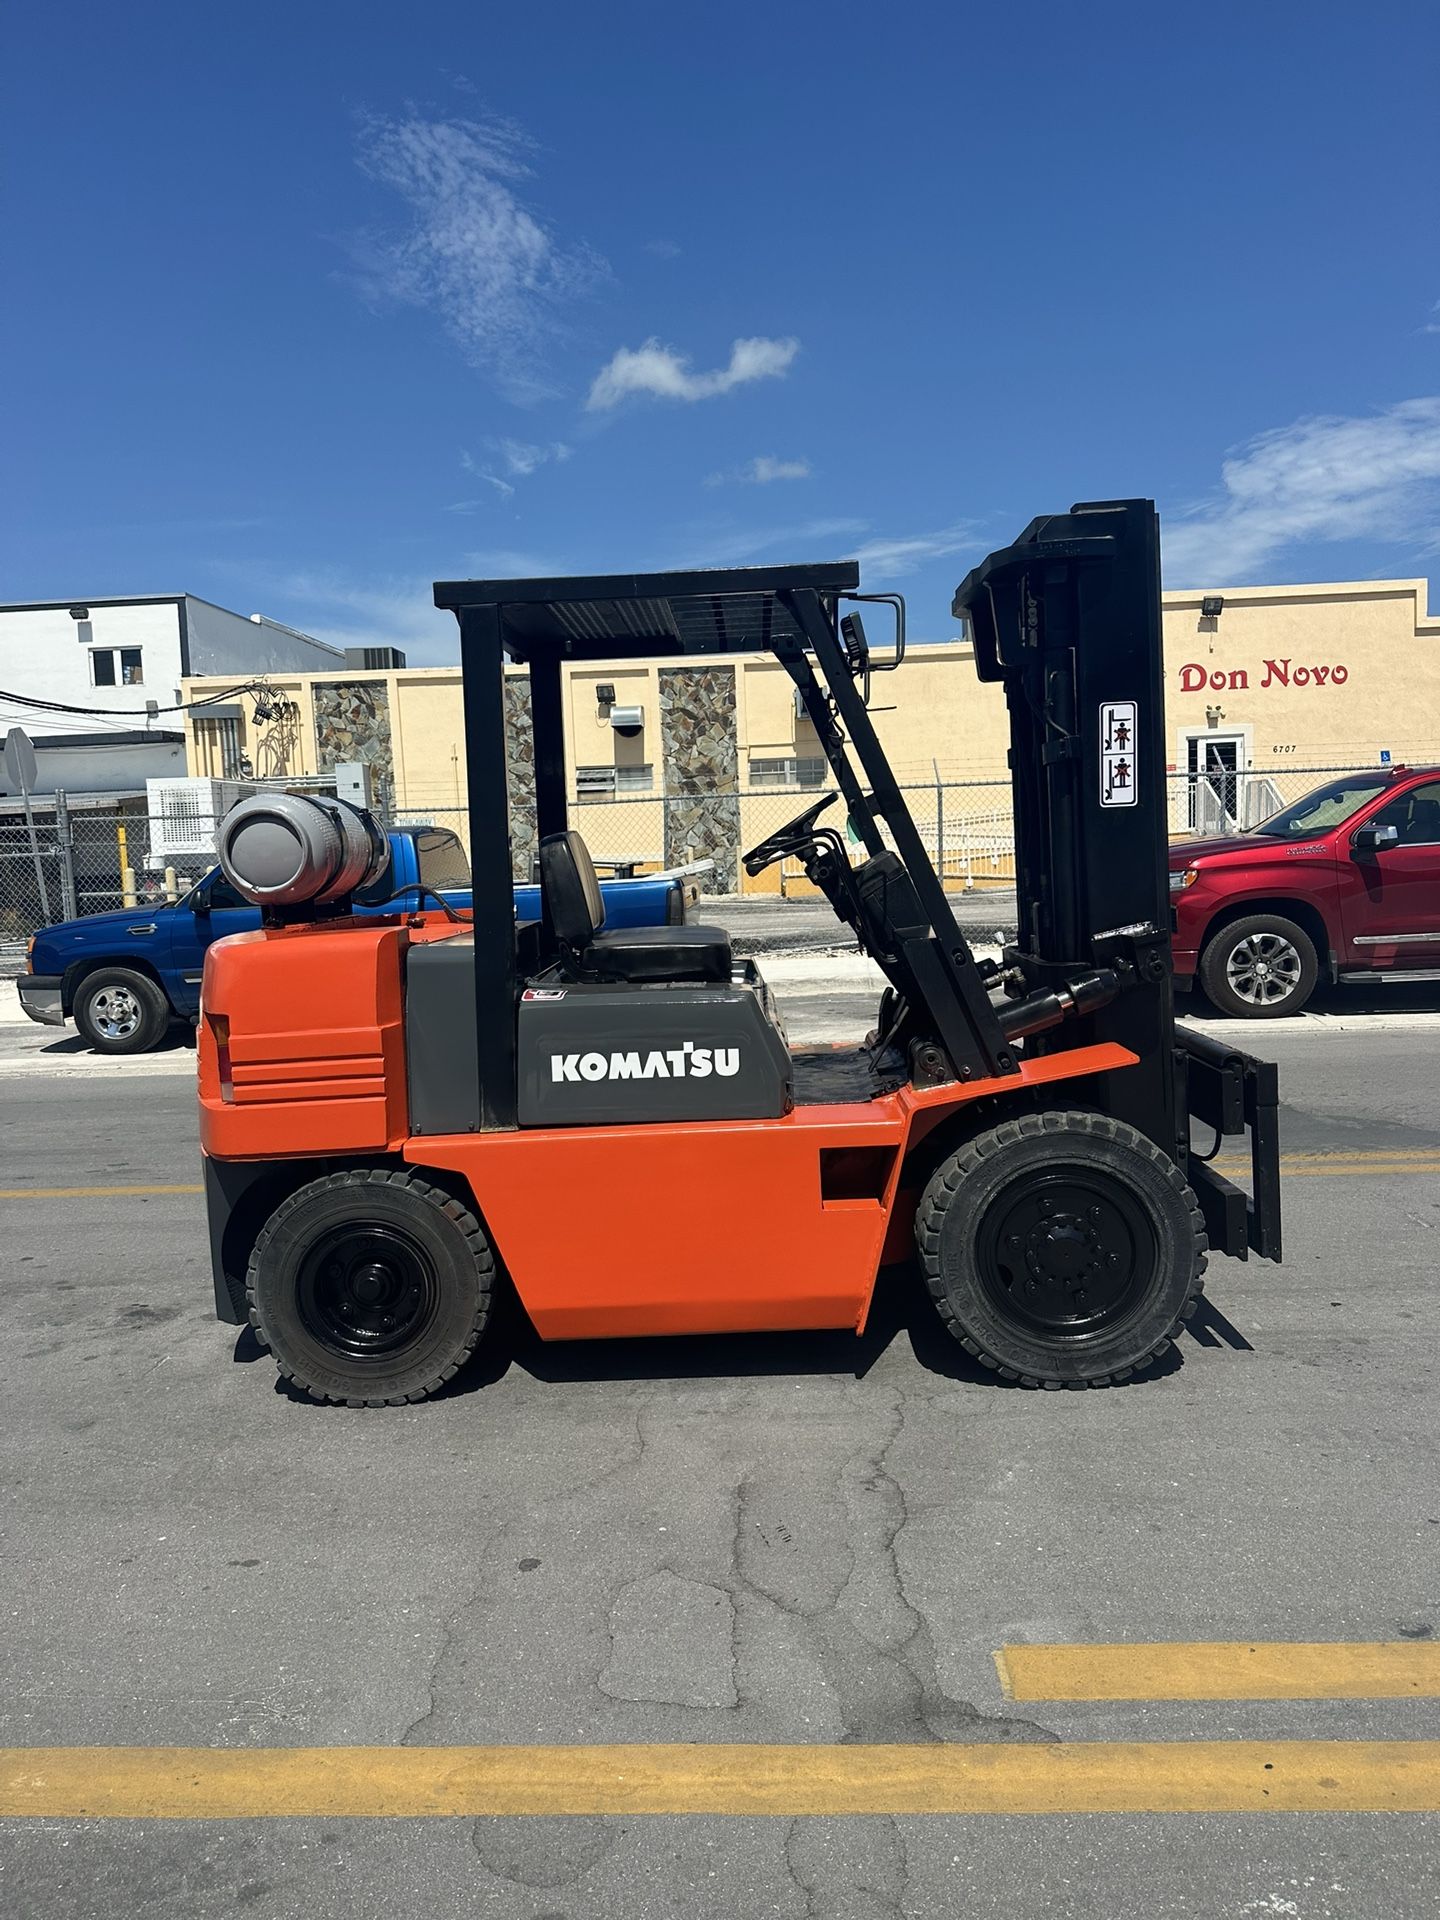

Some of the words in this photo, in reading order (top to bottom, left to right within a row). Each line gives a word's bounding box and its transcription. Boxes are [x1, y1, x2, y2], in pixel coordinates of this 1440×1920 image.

[1179, 663, 1250, 692] Don
[1261, 659, 1348, 688] Novo
[1272, 745, 1297, 754] 6707
[550, 1041, 740, 1082] KOMATSU
